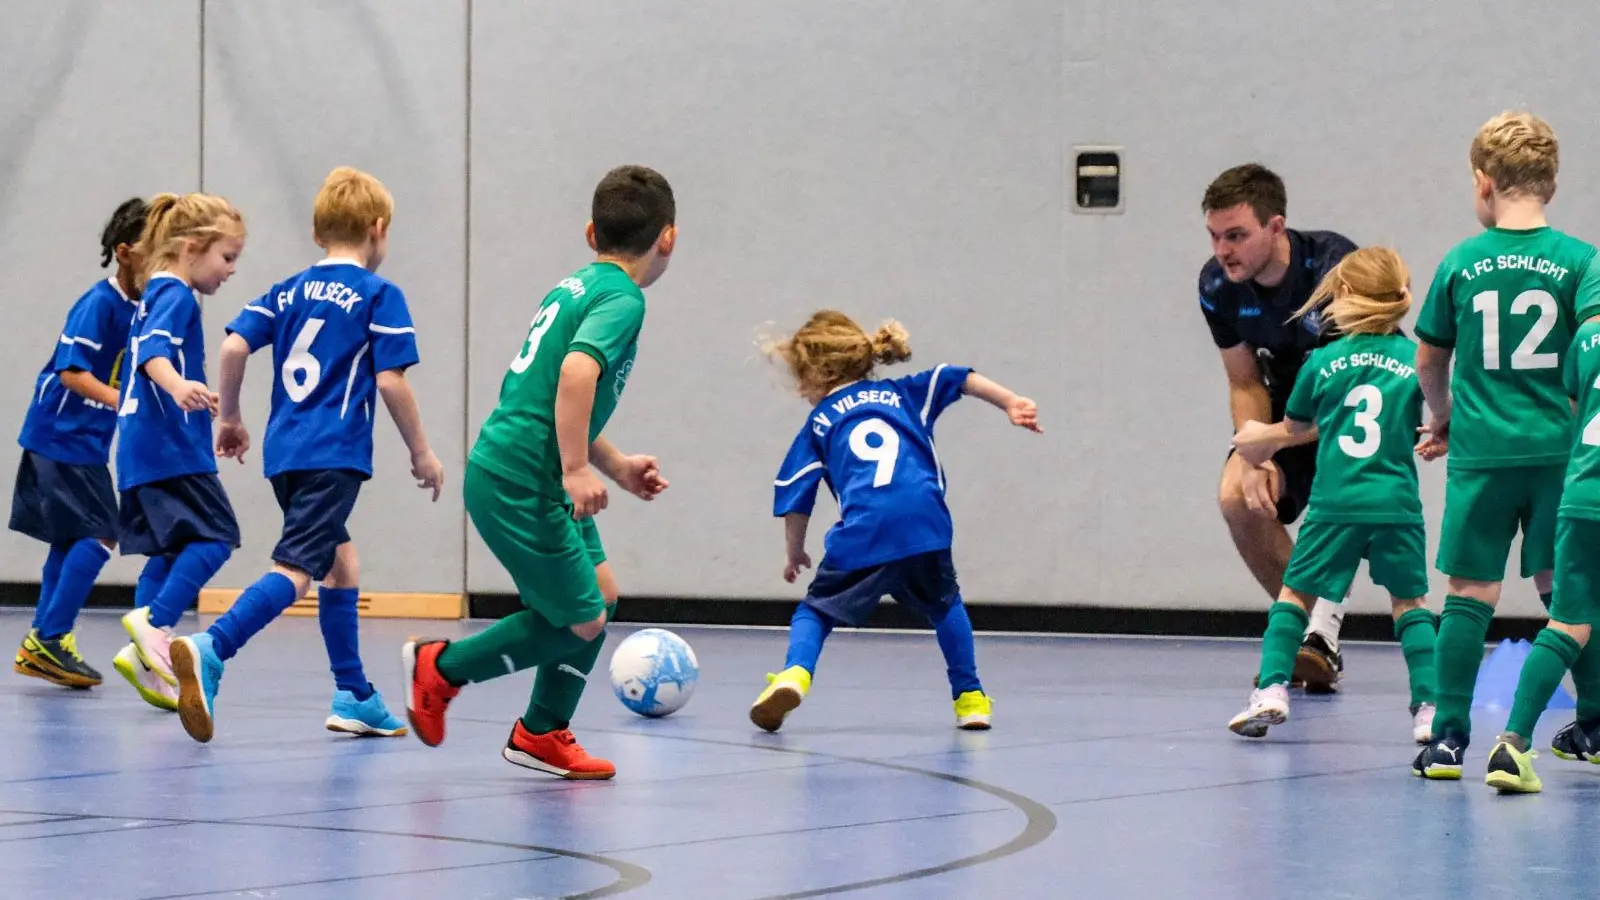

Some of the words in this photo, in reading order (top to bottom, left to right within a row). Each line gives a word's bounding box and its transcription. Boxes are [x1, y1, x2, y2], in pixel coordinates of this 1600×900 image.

[277, 287, 296, 312] FV
[304, 281, 364, 314] VILSECK
[1461, 268, 1476, 281] 1.
[1473, 258, 1494, 276] FC
[1496, 254, 1569, 282] SCHLICHT
[1472, 289, 1559, 370] 12
[281, 317, 326, 402] 6
[1319, 367, 1332, 379] 1.
[1330, 356, 1348, 373] FC
[1349, 352, 1416, 379] SCHLICHT
[813, 412, 832, 437] FV
[831, 389, 903, 414] VILSECK
[1338, 384, 1383, 458] 3
[848, 417, 900, 488] 9
